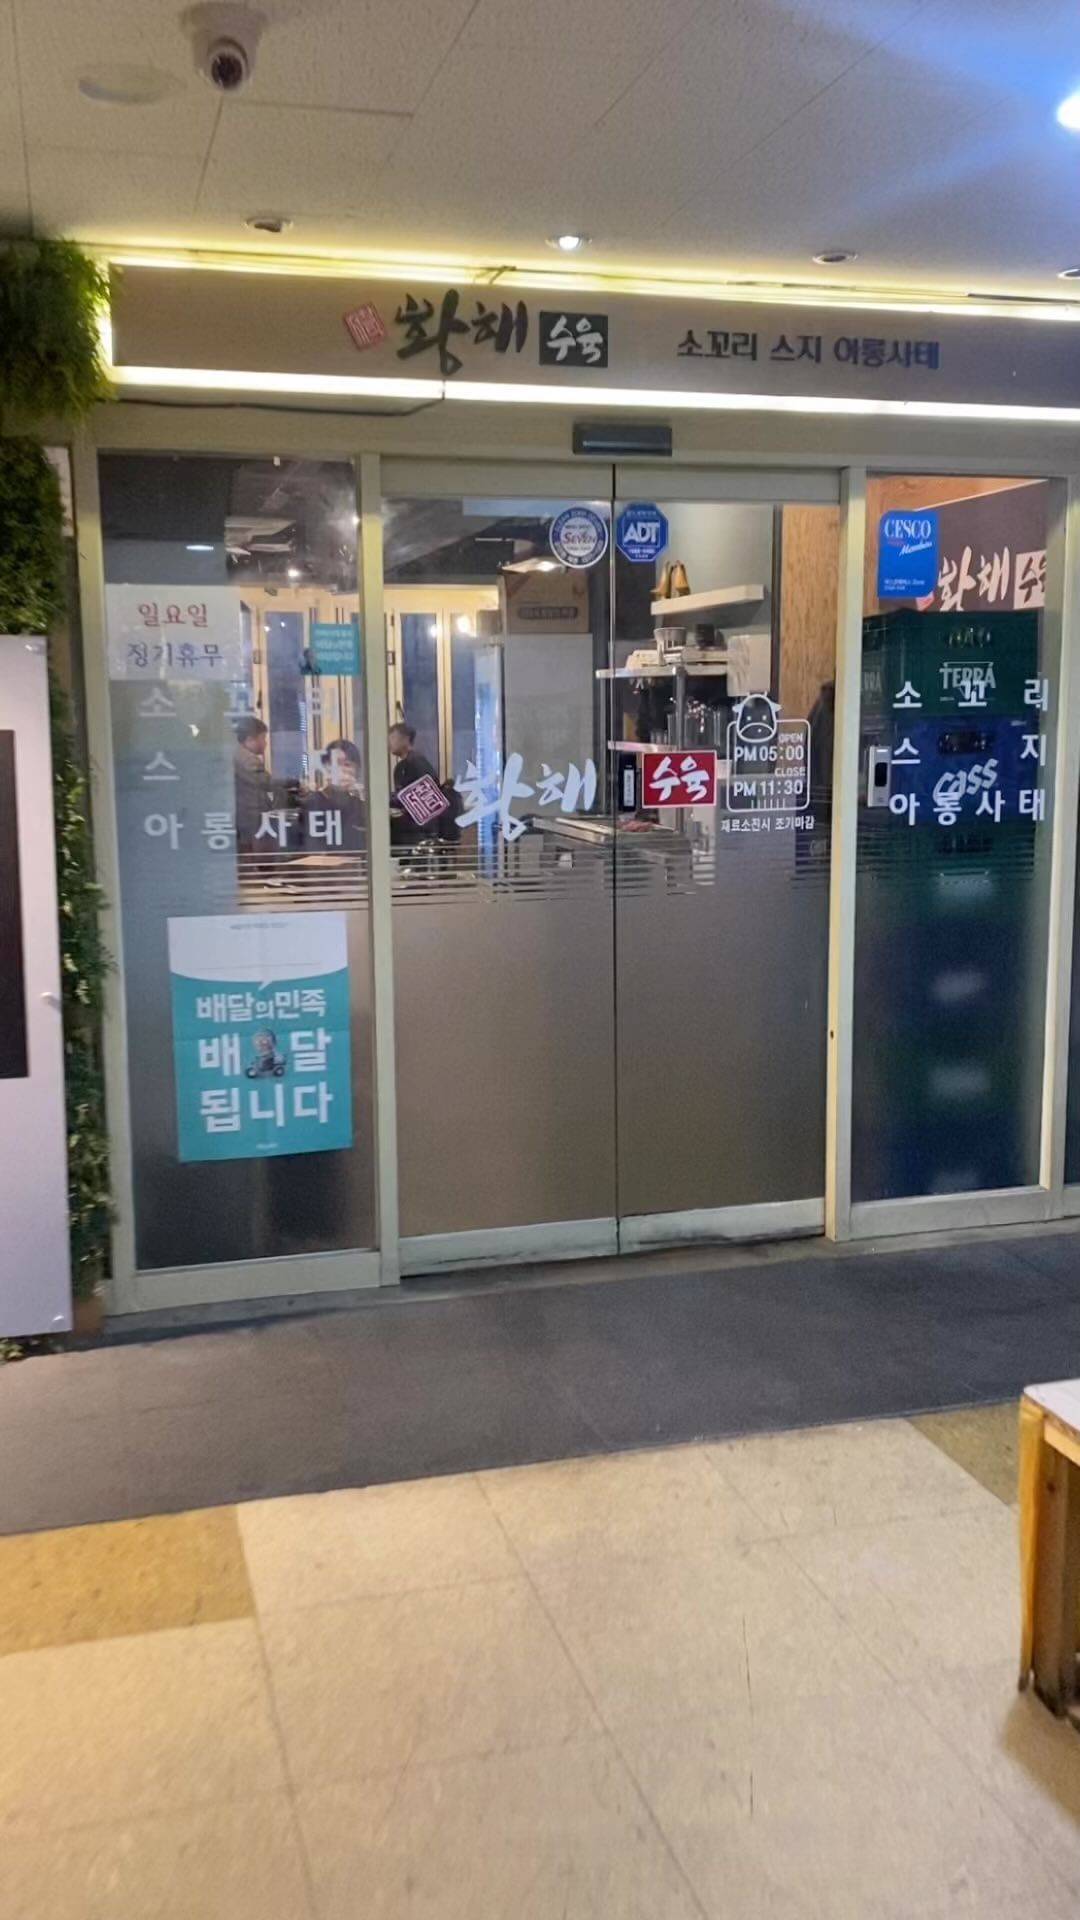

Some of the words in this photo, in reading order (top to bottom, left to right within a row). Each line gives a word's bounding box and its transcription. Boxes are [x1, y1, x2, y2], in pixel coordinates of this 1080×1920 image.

[395, 289, 528, 376] 황해
[547, 315, 604, 365] 수육
[677, 329, 757, 361] 소꼬리
[770, 334, 822, 363] 스지
[833, 336, 940, 369] 아롱사태
[623, 521, 660, 543] ADT
[884, 519, 932, 538] CESCO
[138, 602, 209, 628] 일요일
[128, 641, 224, 668] 정기휴무
[939, 667, 996, 690] TERRA
[778, 733, 804, 743] OPEN
[734, 746, 757, 762] PM
[760, 745, 804, 761] 05:00
[774, 767, 806, 777] CLOSE
[455, 752, 597, 841] 황해
[649, 755, 709, 803] 수육
[734, 781, 756, 796] PM
[760, 780, 803, 795] 11:30
[720, 817, 771, 832] 재료소진시
[775, 815, 815, 831] 조기마감
[196, 989, 327, 1022] 배달의민족
[200, 1082, 333, 1133] 됩니다
